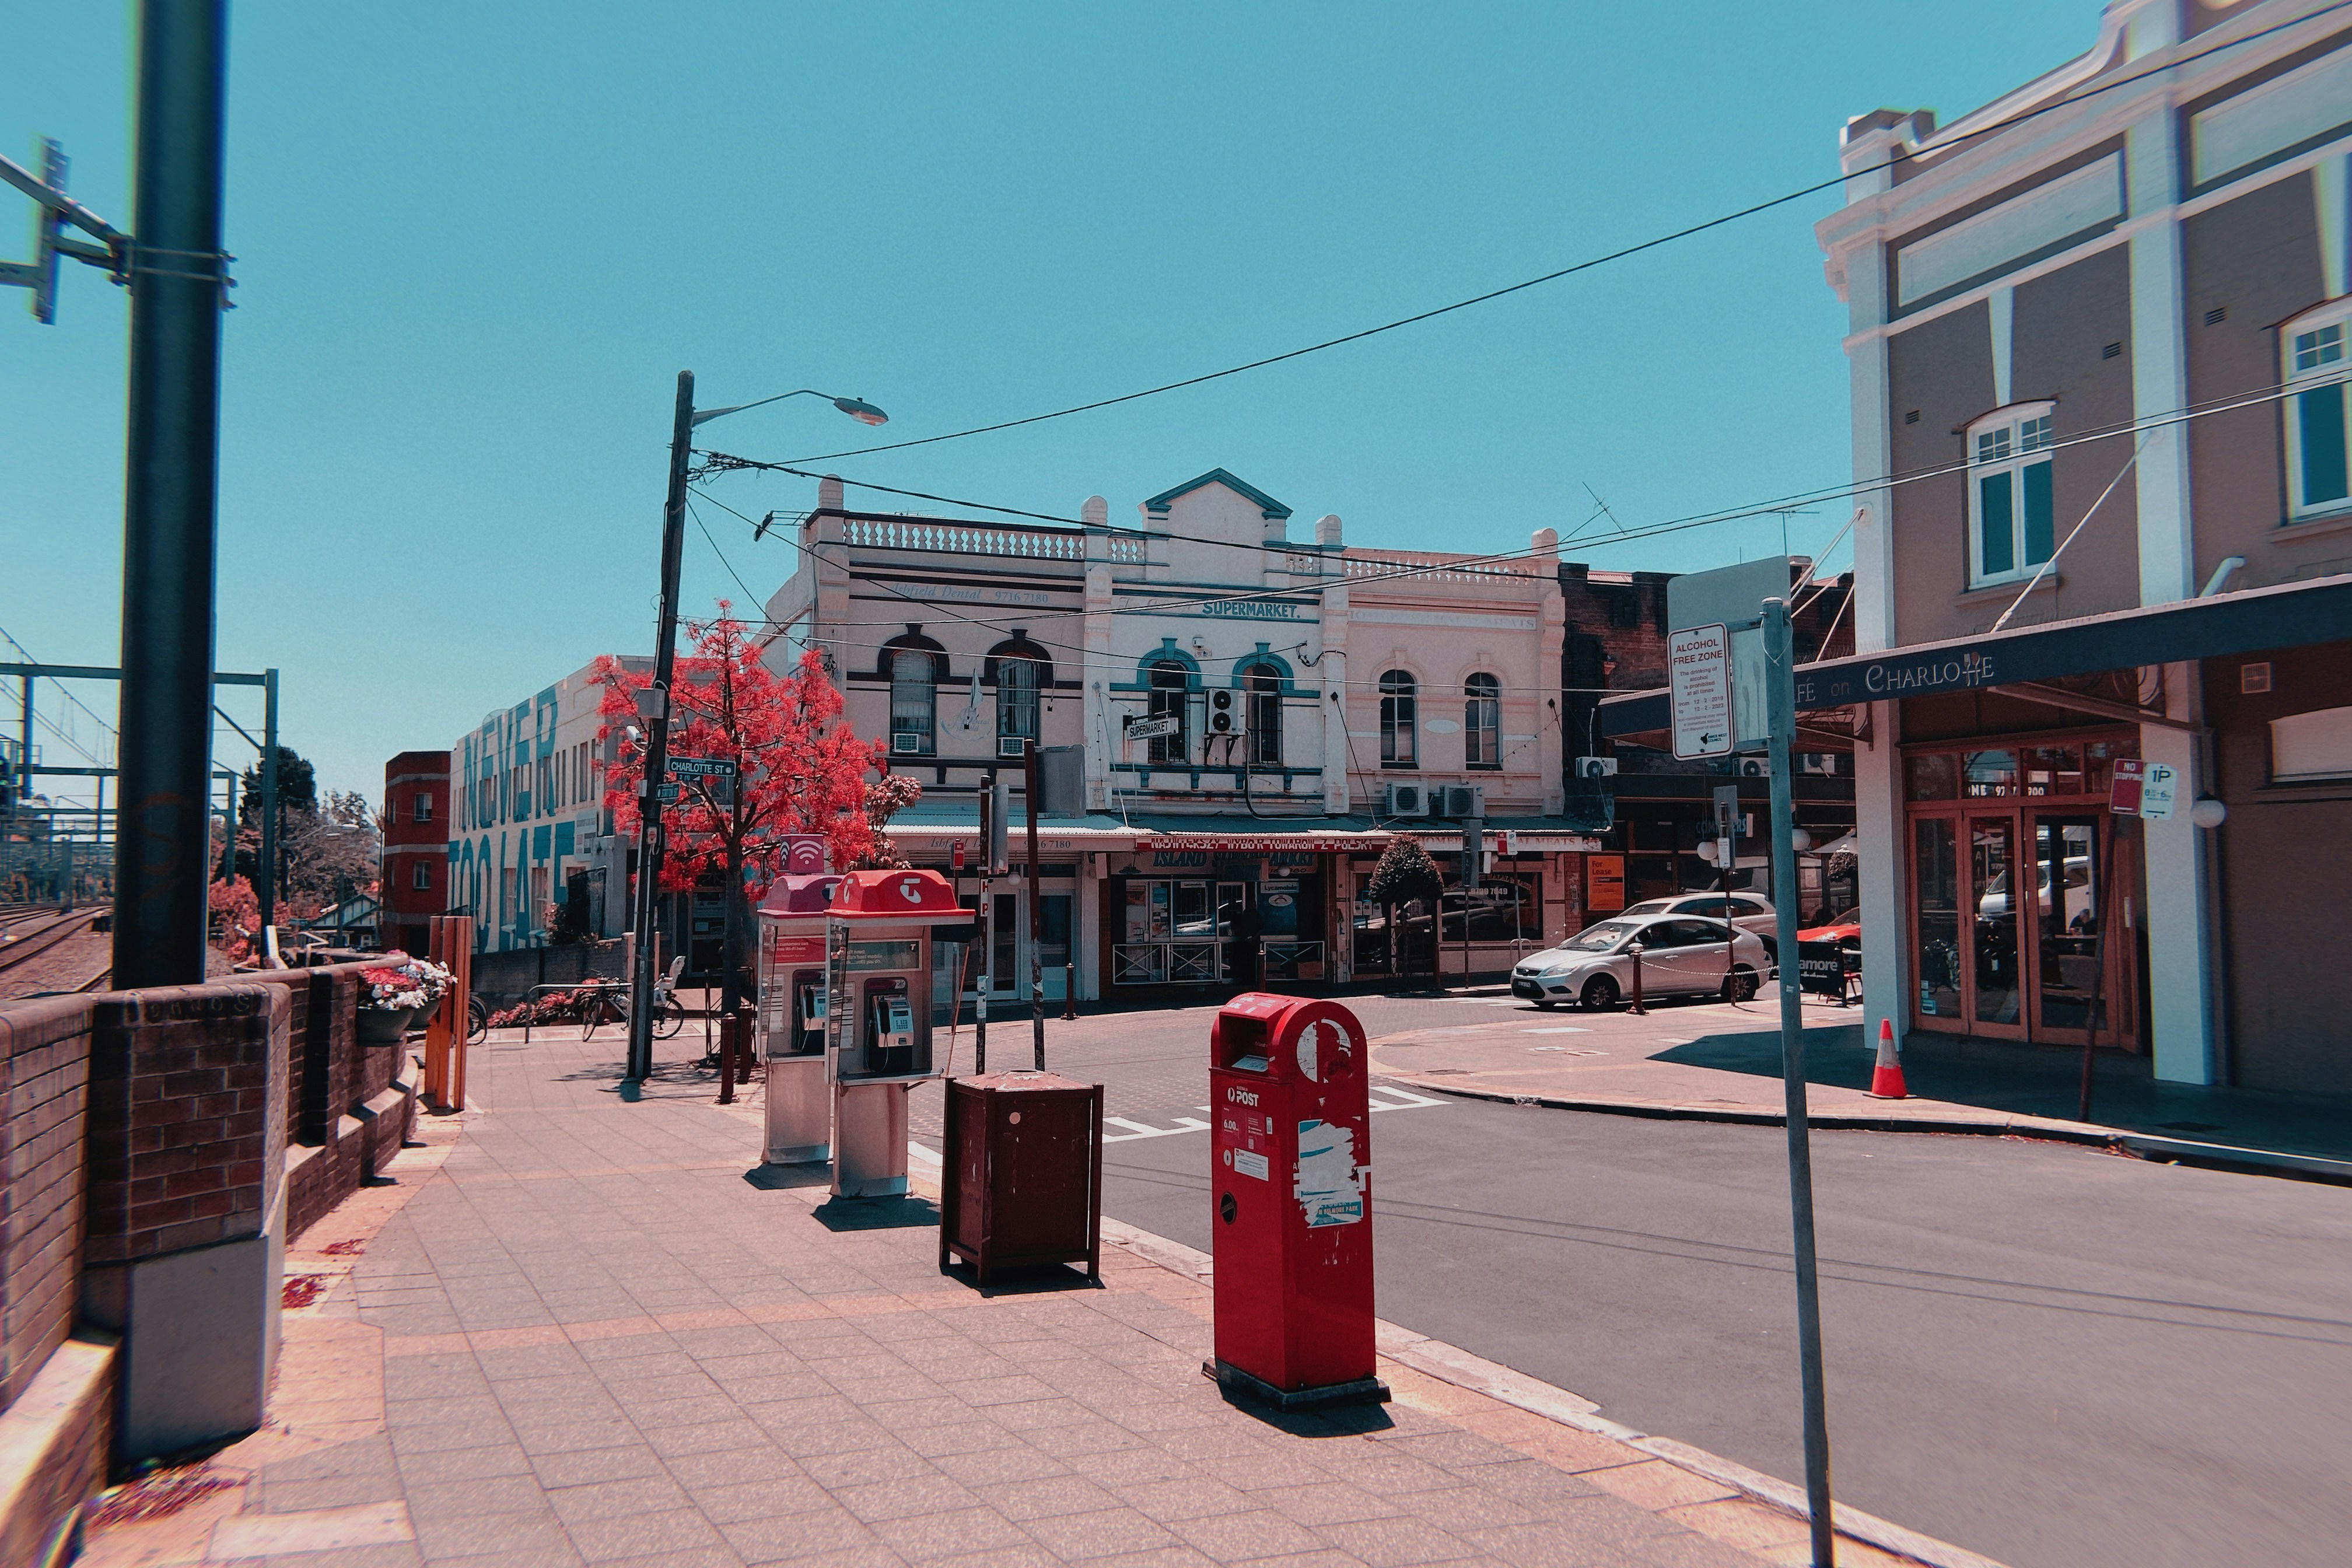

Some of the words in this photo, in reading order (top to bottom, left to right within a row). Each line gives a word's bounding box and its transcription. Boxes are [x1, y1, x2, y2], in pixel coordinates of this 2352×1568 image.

[942, 585, 982, 599] Dental
[995, 590, 1020, 601] 9716
[1024, 593, 1048, 603] 7180
[1676, 639, 1719, 653] ALCOHOL
[1673, 655, 1696, 665] FREE
[1698, 650, 1723, 662] ZONE
[1690, 667, 1711, 676] drinking
[1689, 680, 1715, 690] prohibited
[1831, 681, 1850, 696] on
[1129, 720, 1169, 737] SUPERMARKET
[462, 685, 558, 833] NEVER
[671, 761, 712, 774] CHARLOTTE
[715, 765, 724, 774] ST
[2123, 762, 2136, 771] NO
[2152, 769, 2171, 782] 1P
[1049, 840, 1071, 848] 7180
[1321, 839, 1329, 850] Z
[1535, 836, 1576, 845] MEATS
[1153, 851, 1207, 867] ISLAND
[448, 834, 492, 954] TOO
[499, 821, 575, 953] LATE
[1798, 957, 1838, 971] amoré
[1236, 1090, 1259, 1107] POST
[1224, 1119, 1236, 1130] 6.00
